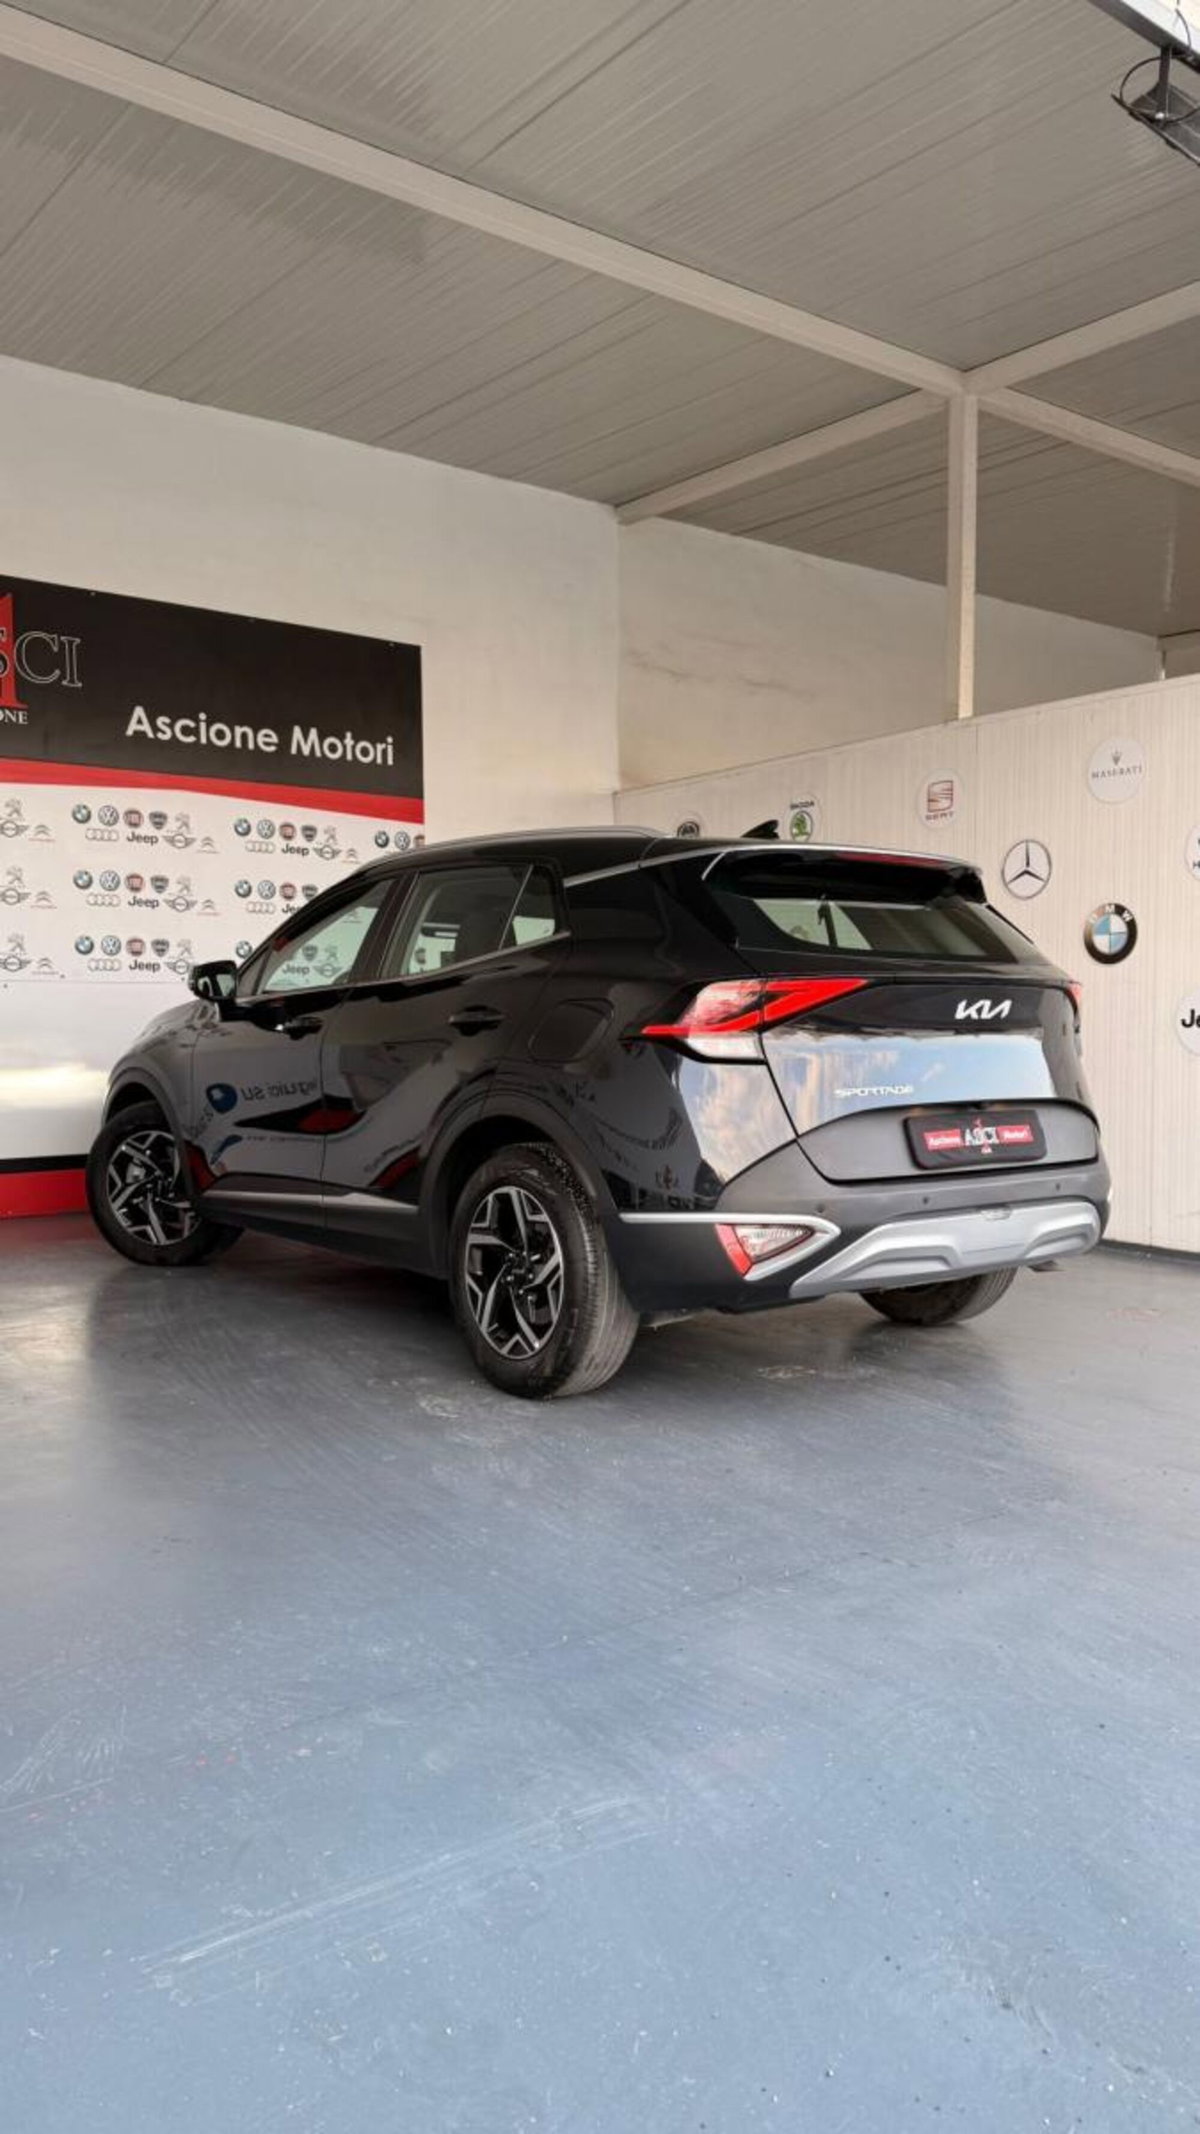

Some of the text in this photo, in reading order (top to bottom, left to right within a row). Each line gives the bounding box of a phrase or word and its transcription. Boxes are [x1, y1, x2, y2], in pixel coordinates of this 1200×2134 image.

[126, 705, 394, 765] Ascione Motori
[126, 831, 159, 846] Jeep
[281, 843, 310, 858] Jeep
[128, 896, 160, 909] Jeep
[129, 959, 161, 973] Jeep
[955, 999, 1012, 1020] KIA
